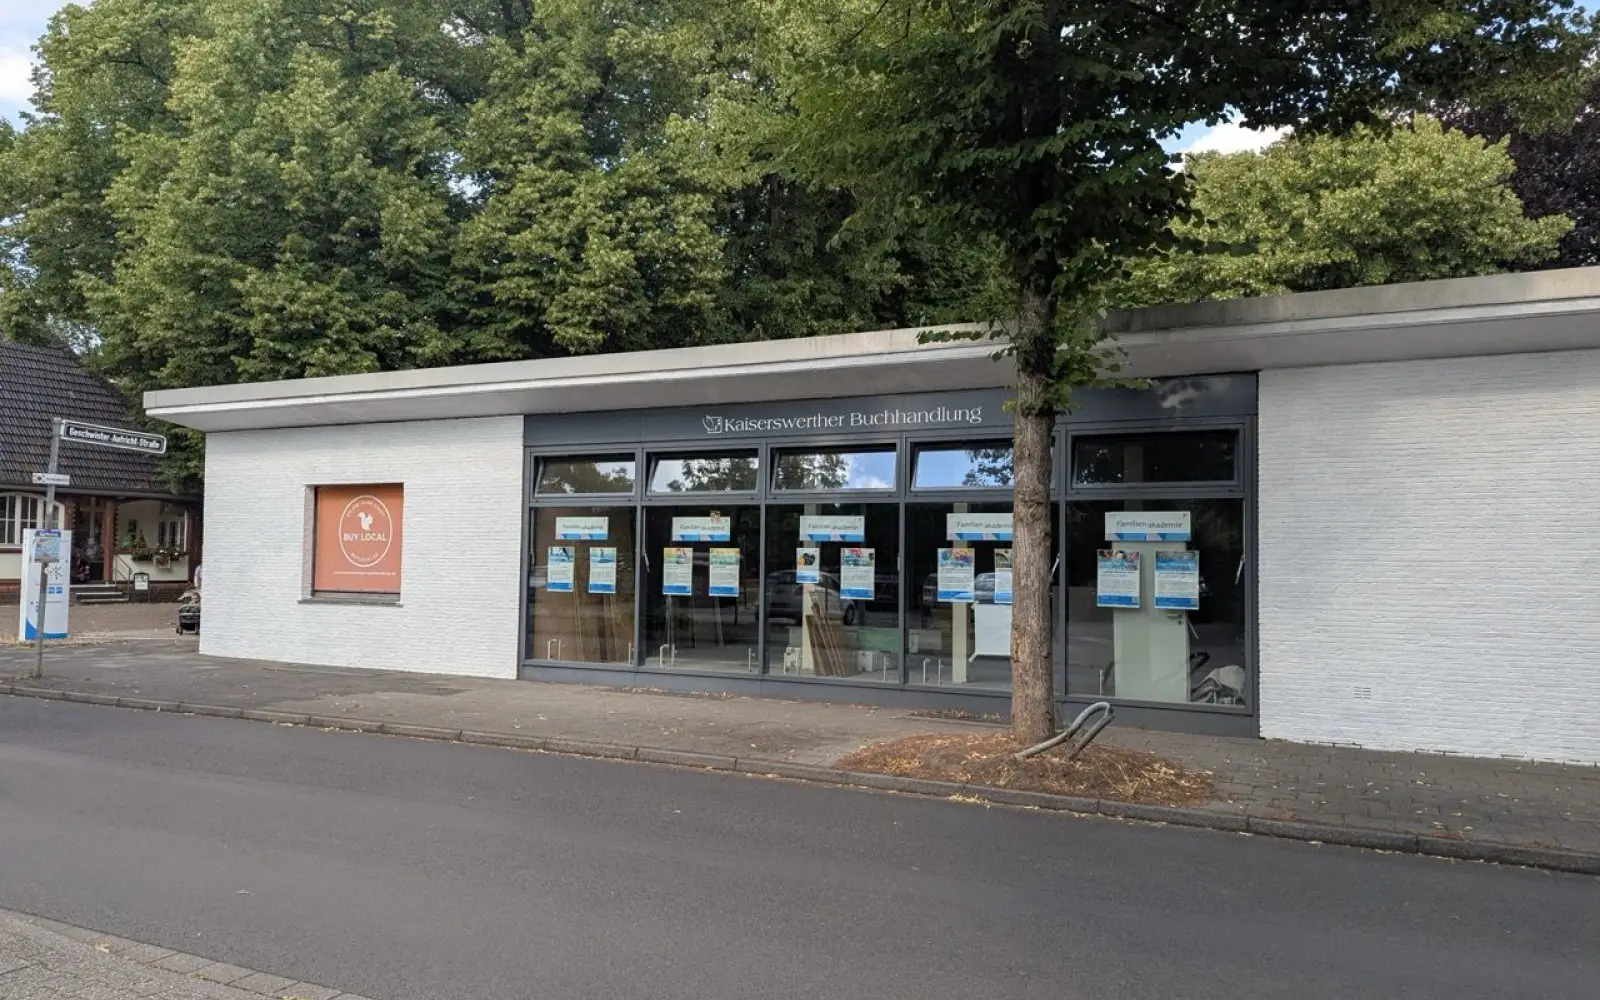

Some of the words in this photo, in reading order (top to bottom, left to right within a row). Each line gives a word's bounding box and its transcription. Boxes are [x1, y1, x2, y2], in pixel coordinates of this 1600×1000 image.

[725, 414, 844, 433] Kaiserswerther
[850, 406, 983, 427] Buchhandlung
[343, 533, 359, 542] BUY
[360, 533, 388, 542] LOCAL
